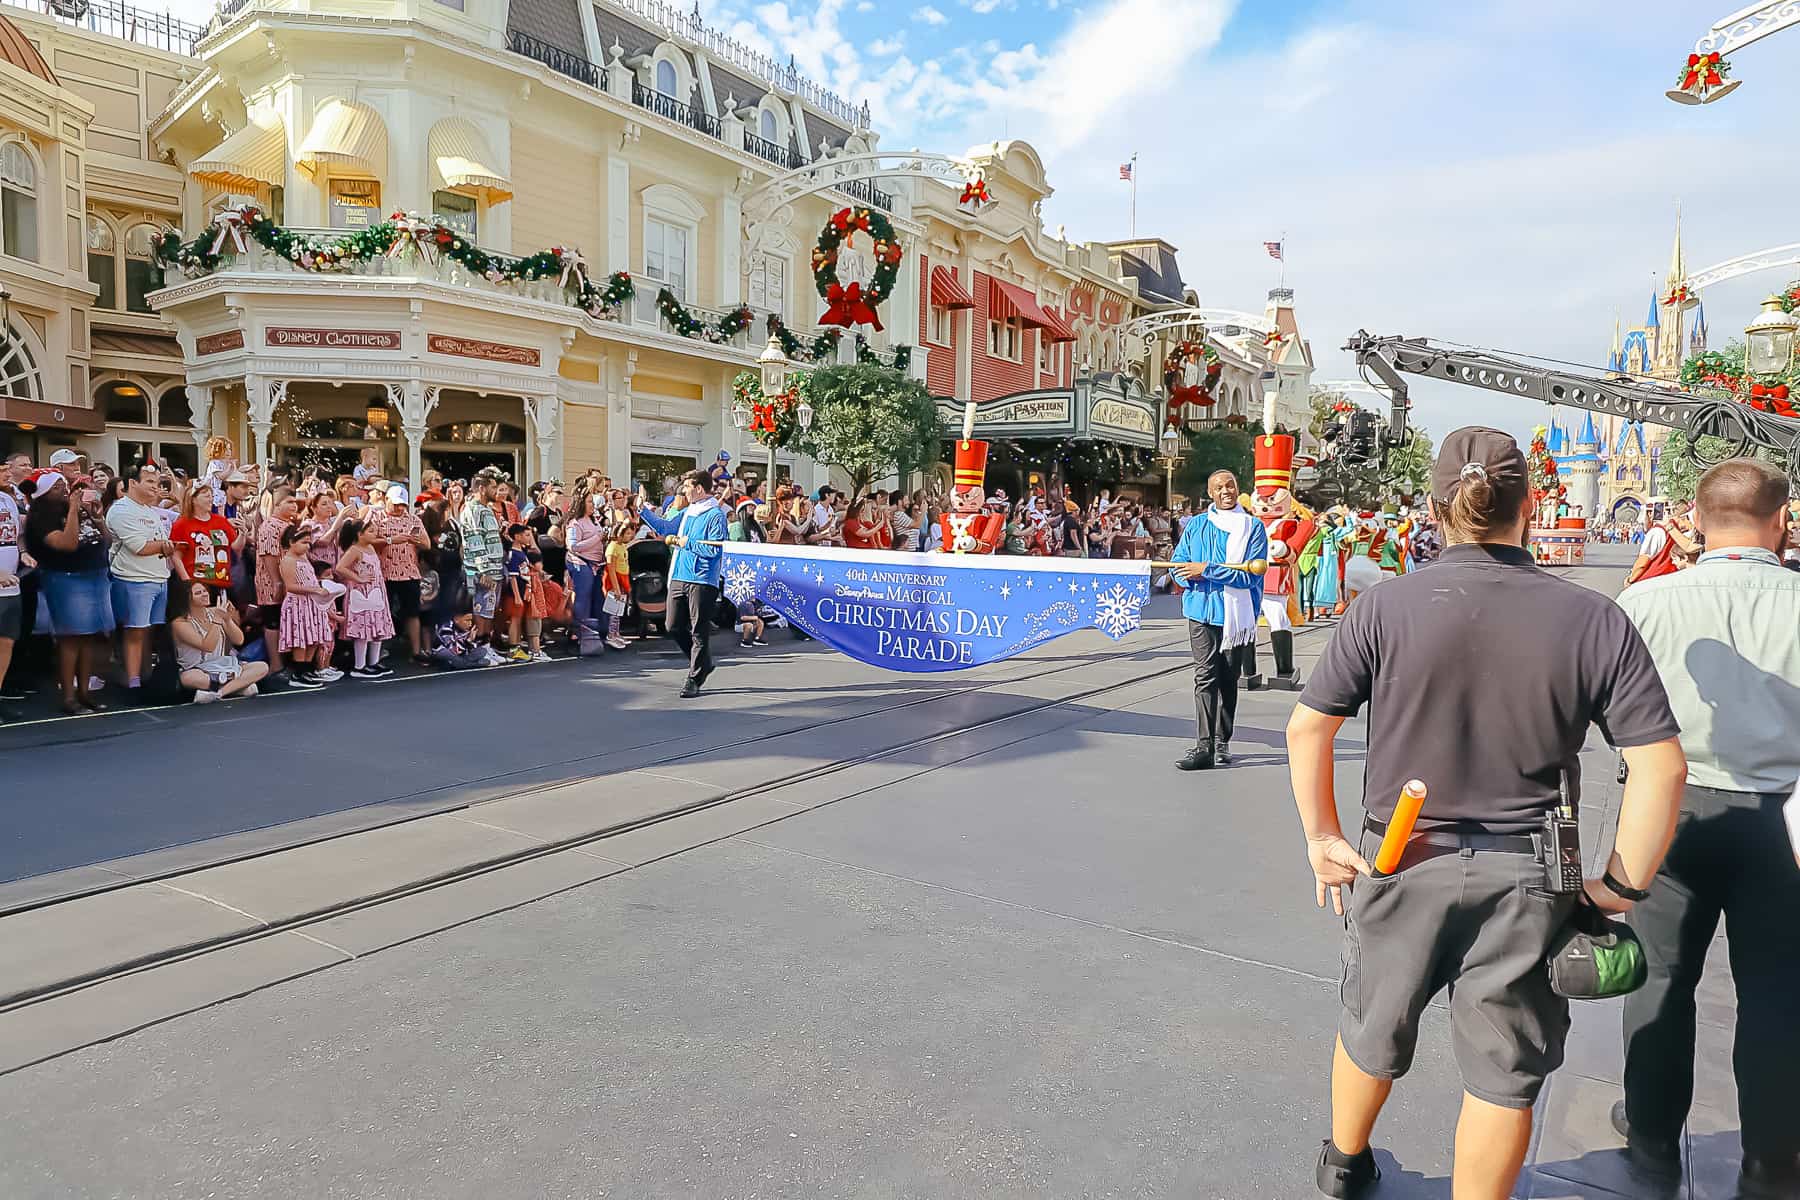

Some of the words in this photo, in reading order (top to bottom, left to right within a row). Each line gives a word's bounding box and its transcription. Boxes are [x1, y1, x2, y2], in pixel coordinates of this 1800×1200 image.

[325, 332, 391, 347] CLOTHIERS
[1014, 401, 1064, 420] FASHION
[845, 568, 868, 582] 40th
[870, 571, 947, 587] ANNIVERSARY
[886, 585, 955, 606] MAGICAL
[816, 598, 950, 633] CHRISTMAS
[955, 609, 1008, 638] DAY
[876, 630, 974, 665] PARADE
